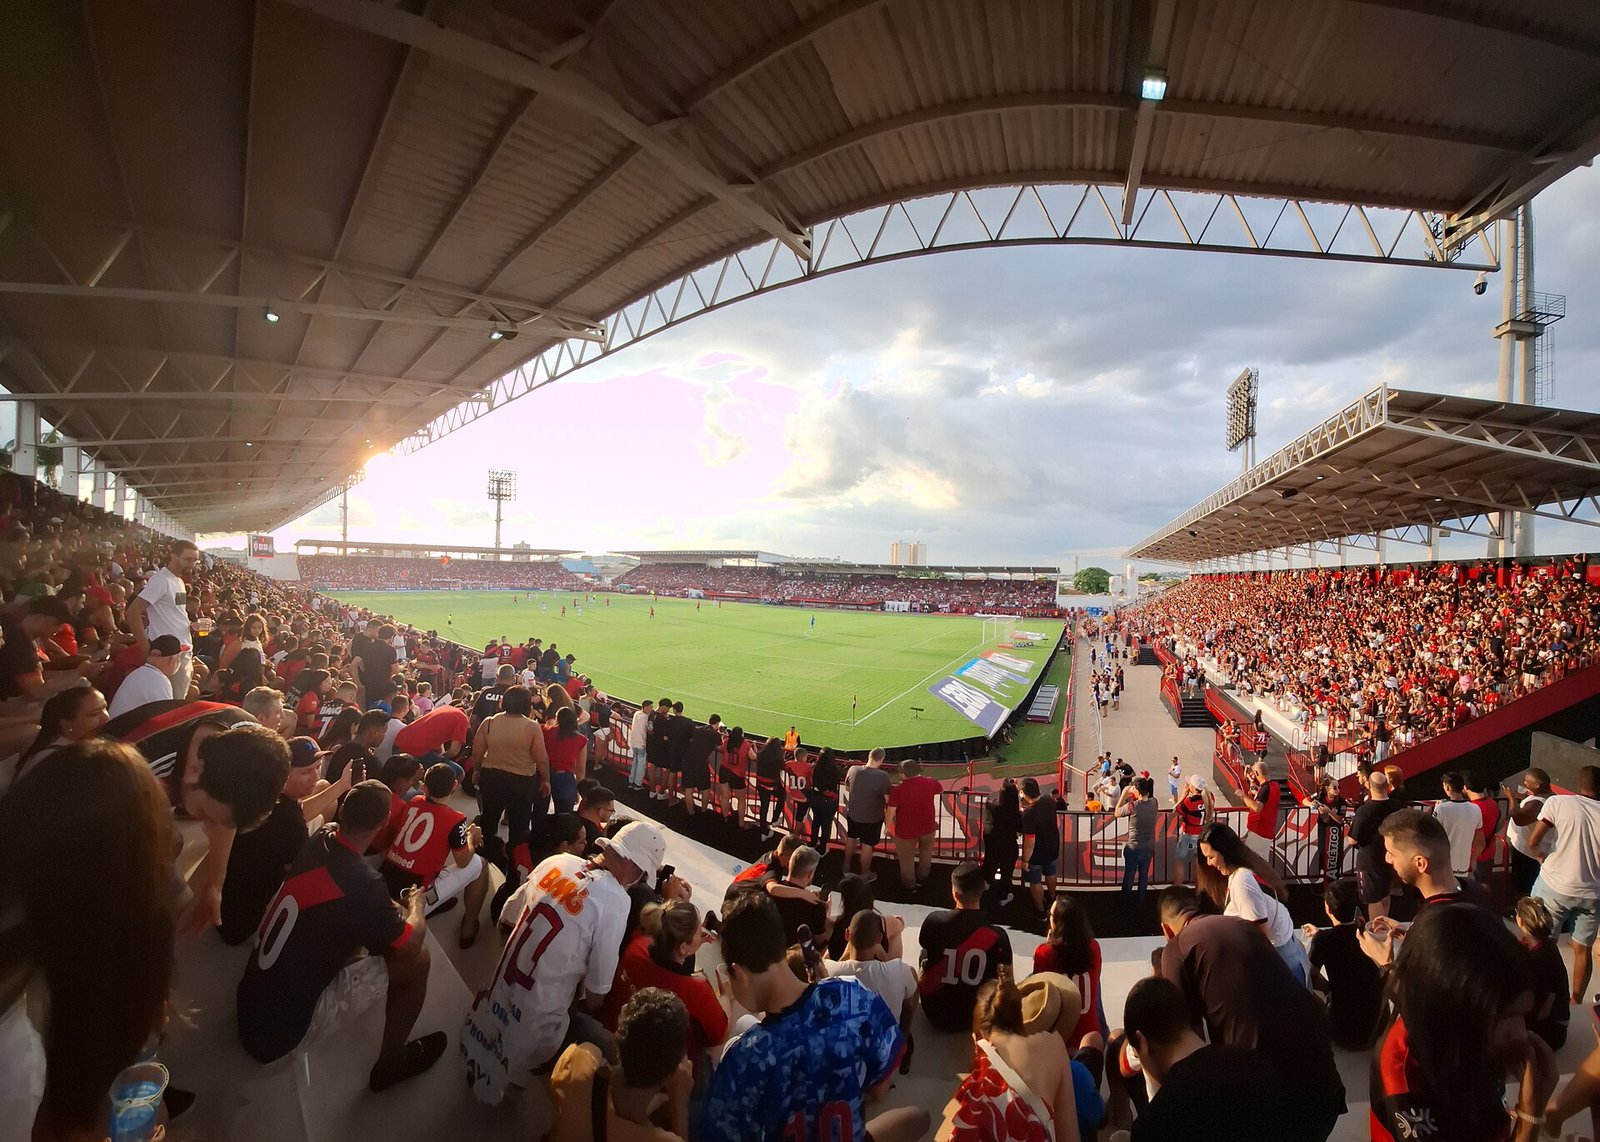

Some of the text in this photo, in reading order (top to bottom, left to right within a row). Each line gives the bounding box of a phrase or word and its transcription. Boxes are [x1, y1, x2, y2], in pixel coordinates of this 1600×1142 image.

[789, 776, 807, 790] 10
[394, 806, 435, 854] 10
[1325, 826, 1340, 880] ATLÉTICO
[537, 867, 590, 916] BMG
[256, 882, 299, 971] 0
[941, 947, 987, 987] 10
[1066, 971, 1092, 1015] 0
